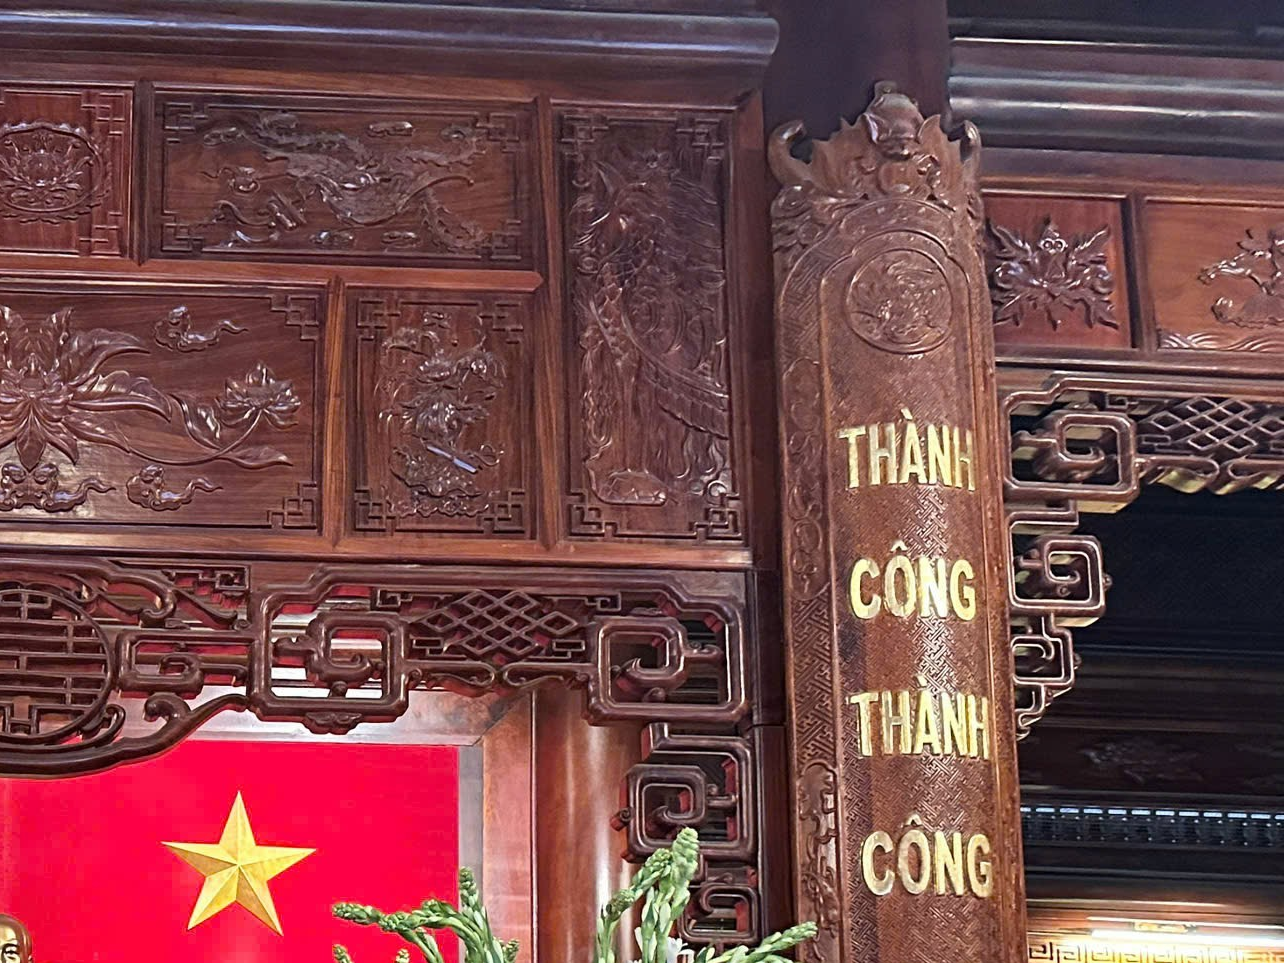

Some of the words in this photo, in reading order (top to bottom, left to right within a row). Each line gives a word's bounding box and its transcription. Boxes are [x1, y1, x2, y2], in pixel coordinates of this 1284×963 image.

[838, 407, 977, 492] THÀNH
[848, 543, 977, 622] CÔNG
[848, 676, 991, 762] THÀNH
[860, 812, 995, 901] CÔNG
